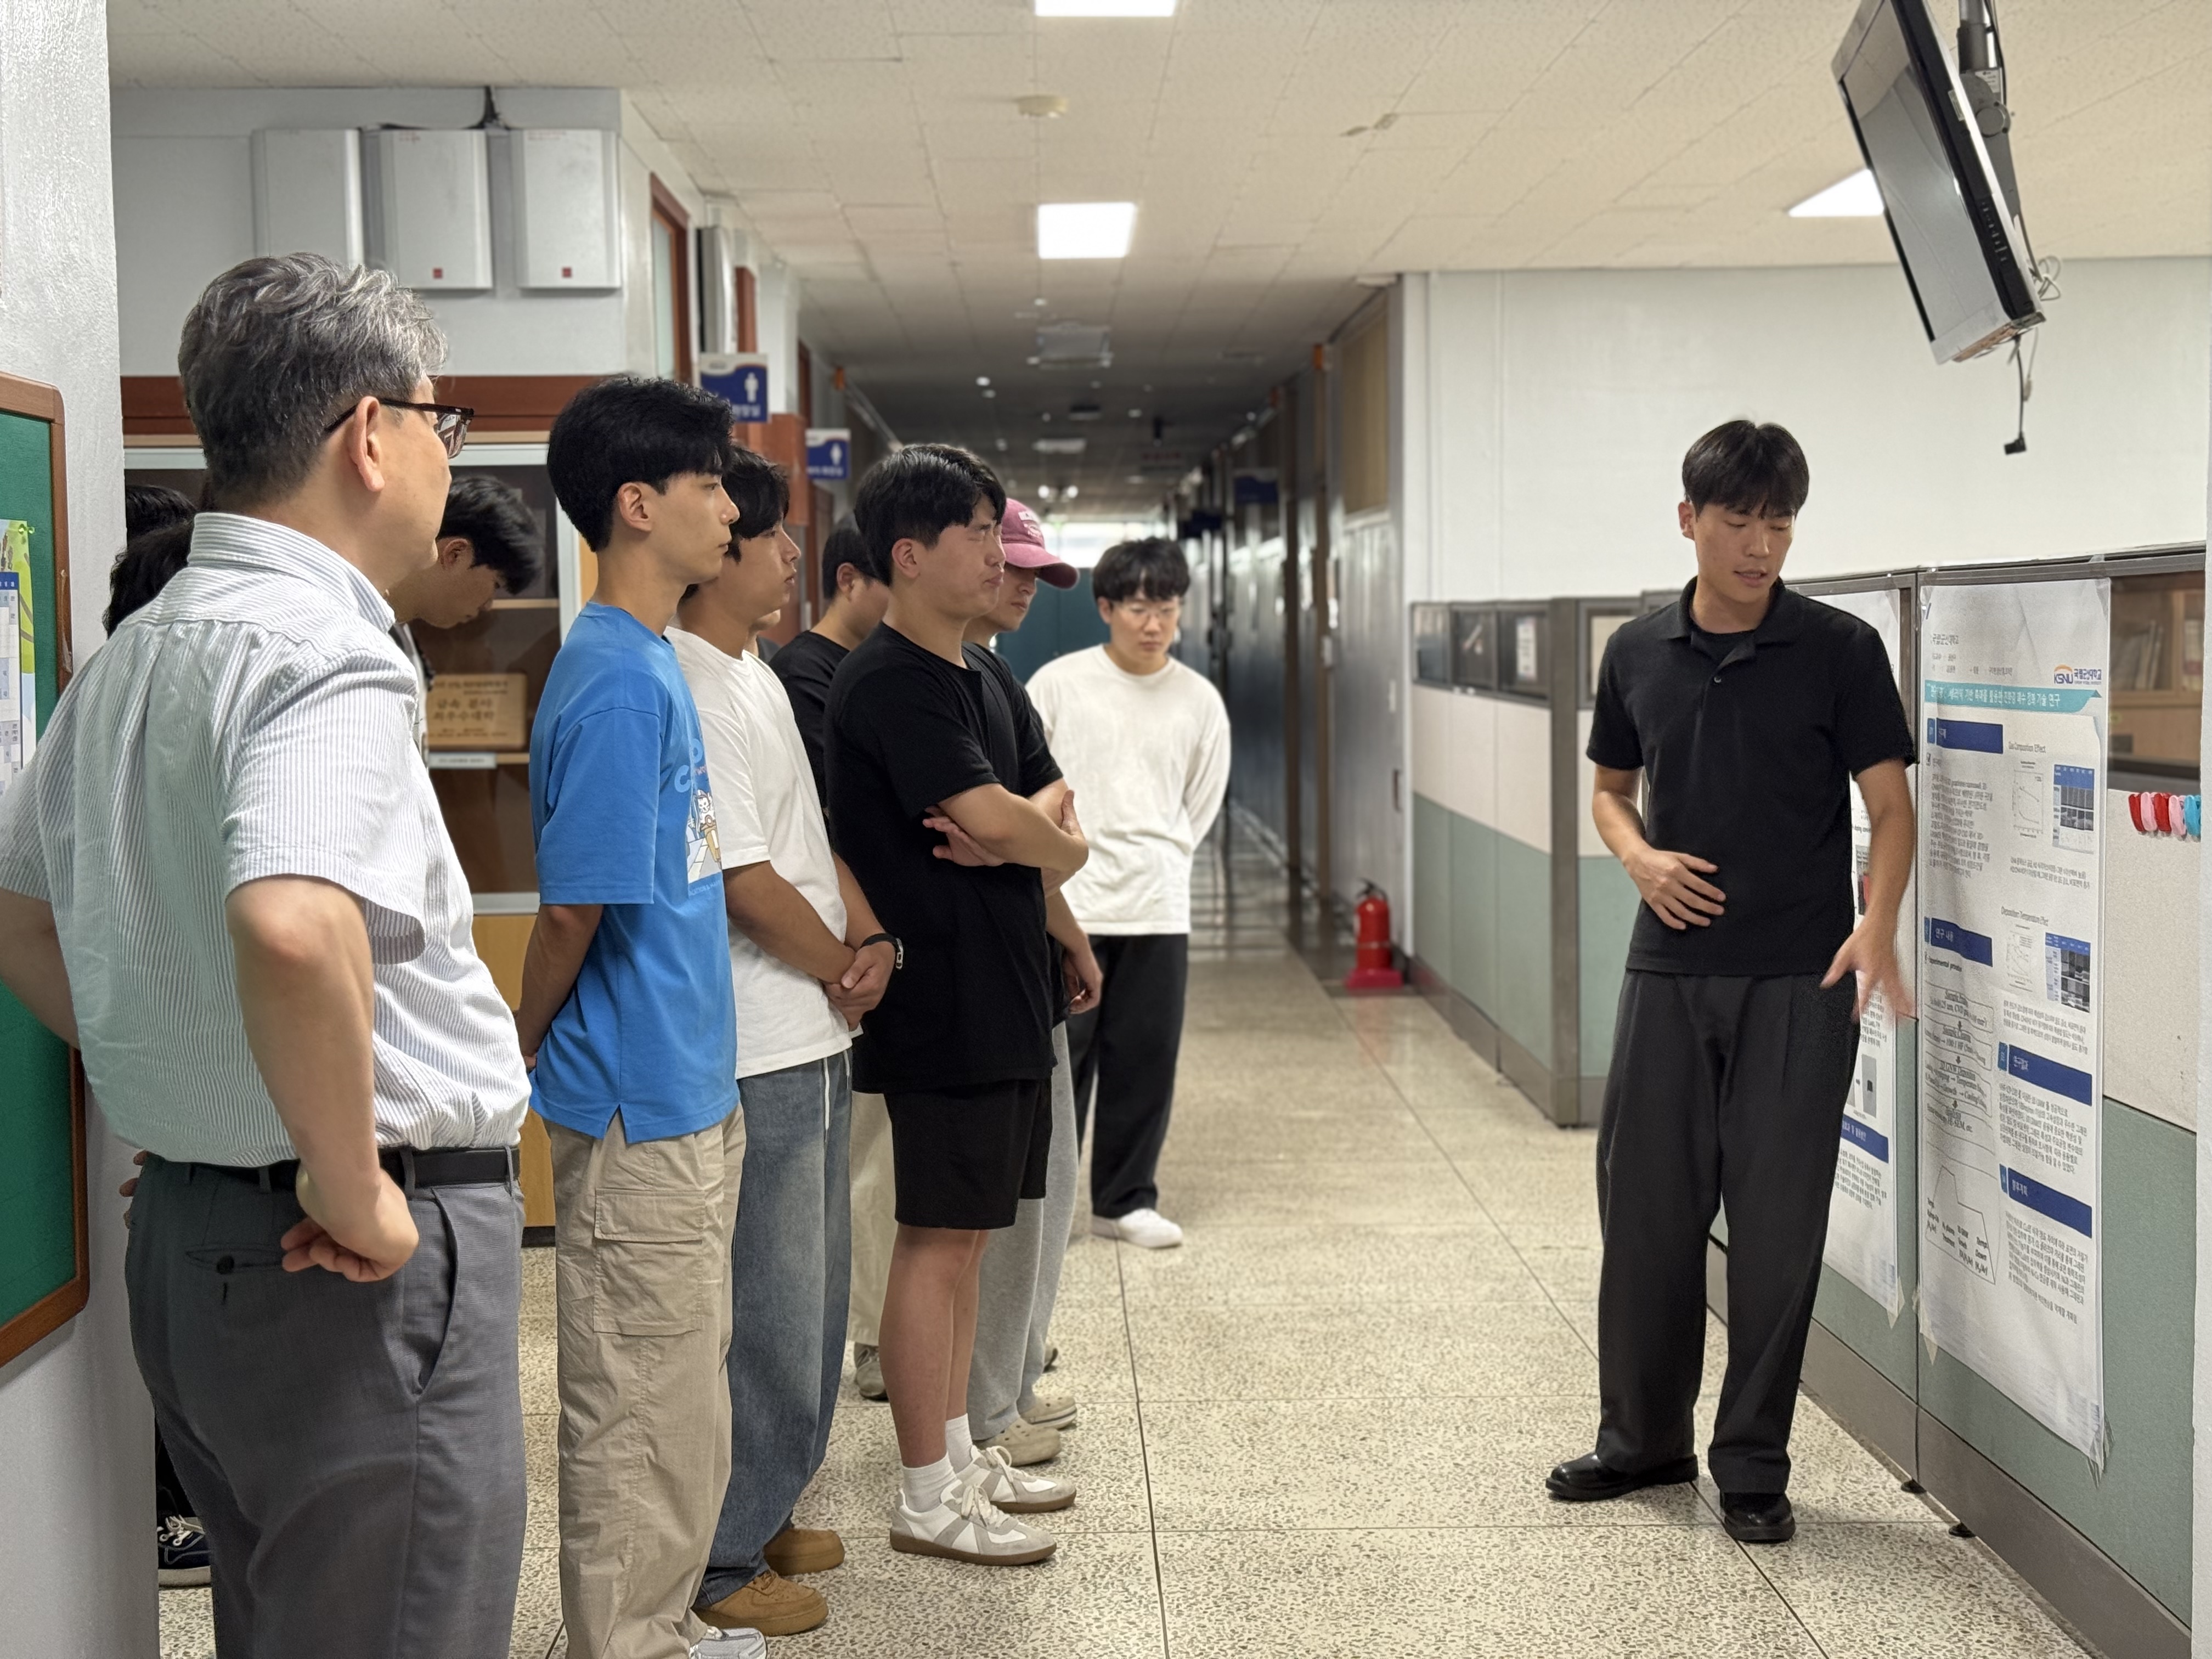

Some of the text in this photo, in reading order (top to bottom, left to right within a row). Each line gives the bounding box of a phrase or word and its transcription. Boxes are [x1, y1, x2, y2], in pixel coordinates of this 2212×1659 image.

[2054, 673, 2073, 684] KSNU
[2037, 693, 2046, 707] 기술
[2048, 693, 2061, 707] 연구
[1935, 927, 1954, 942] 연구 내용
